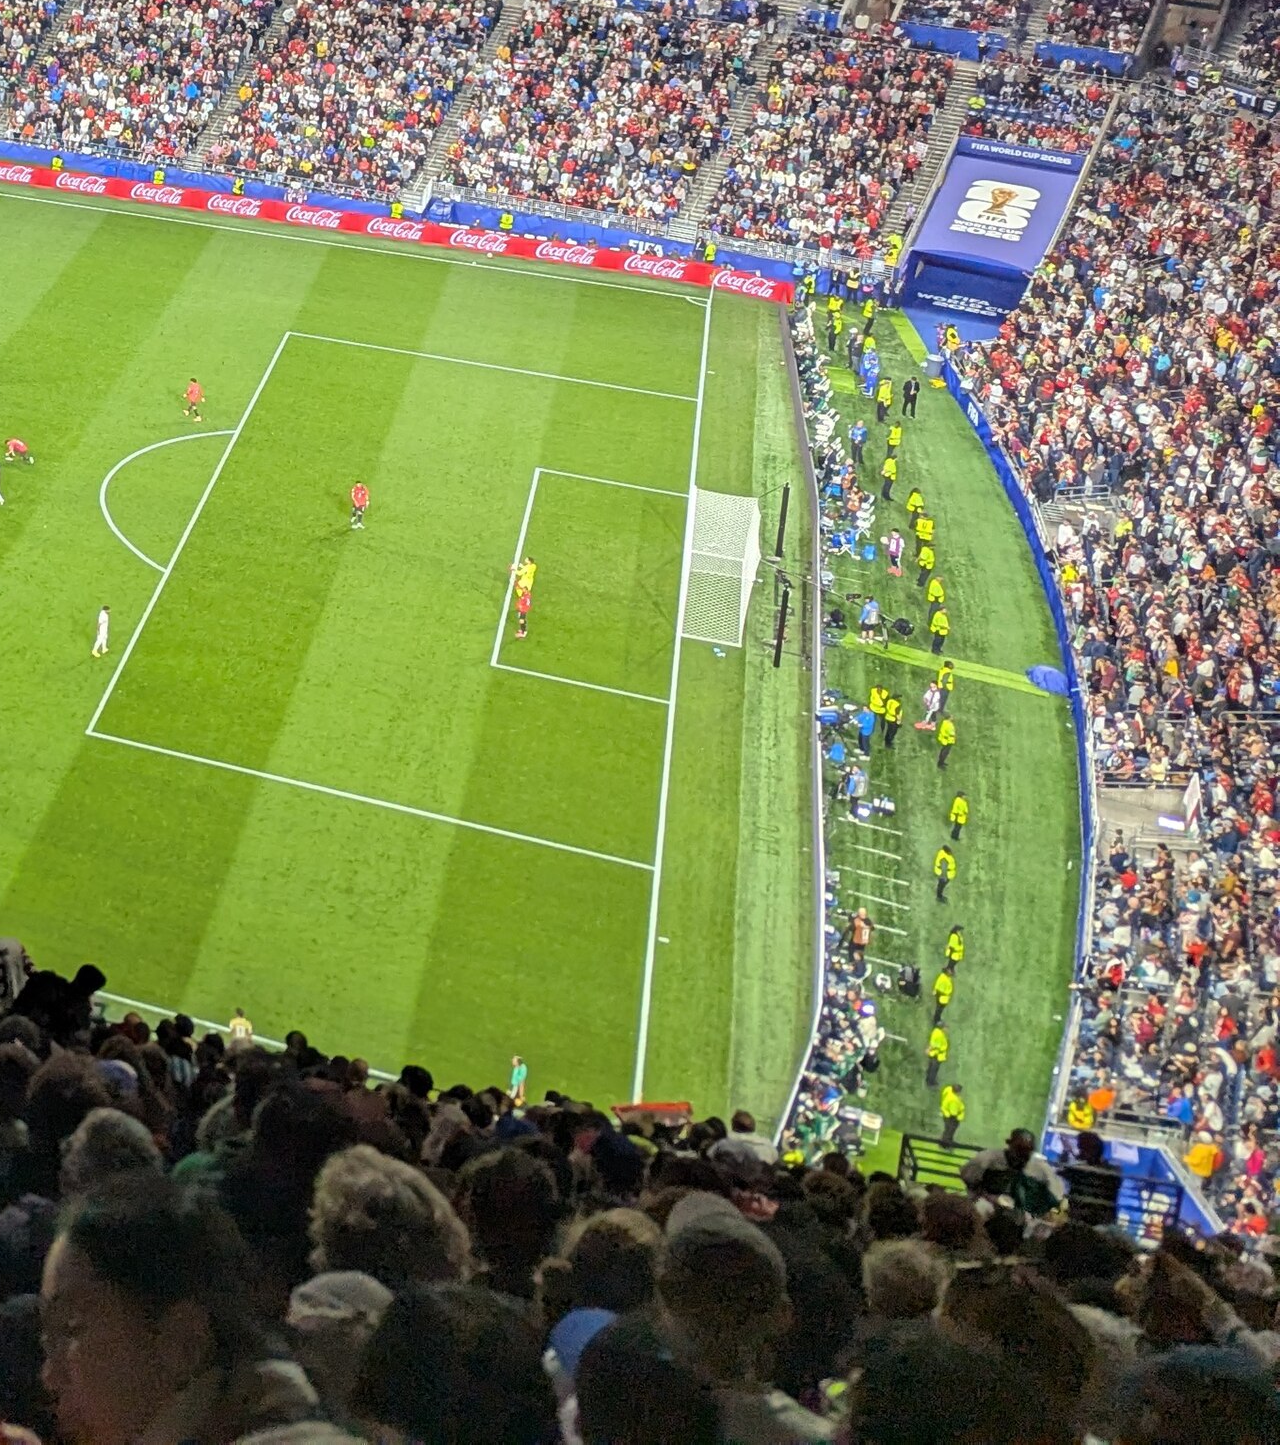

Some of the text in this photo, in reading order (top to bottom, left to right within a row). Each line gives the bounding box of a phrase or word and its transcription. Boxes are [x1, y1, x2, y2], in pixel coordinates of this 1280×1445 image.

[970, 142, 1072, 165] FIFA WORLD CUP 2026
[953, 219, 1024, 236] WORLD CUP
[977, 214, 1008, 224] FIFA
[949, 224, 1021, 242] 2026
[917, 292, 989, 311] WORLD
[951, 293, 990, 306] FIFA
[932, 301, 998, 317] 2026
